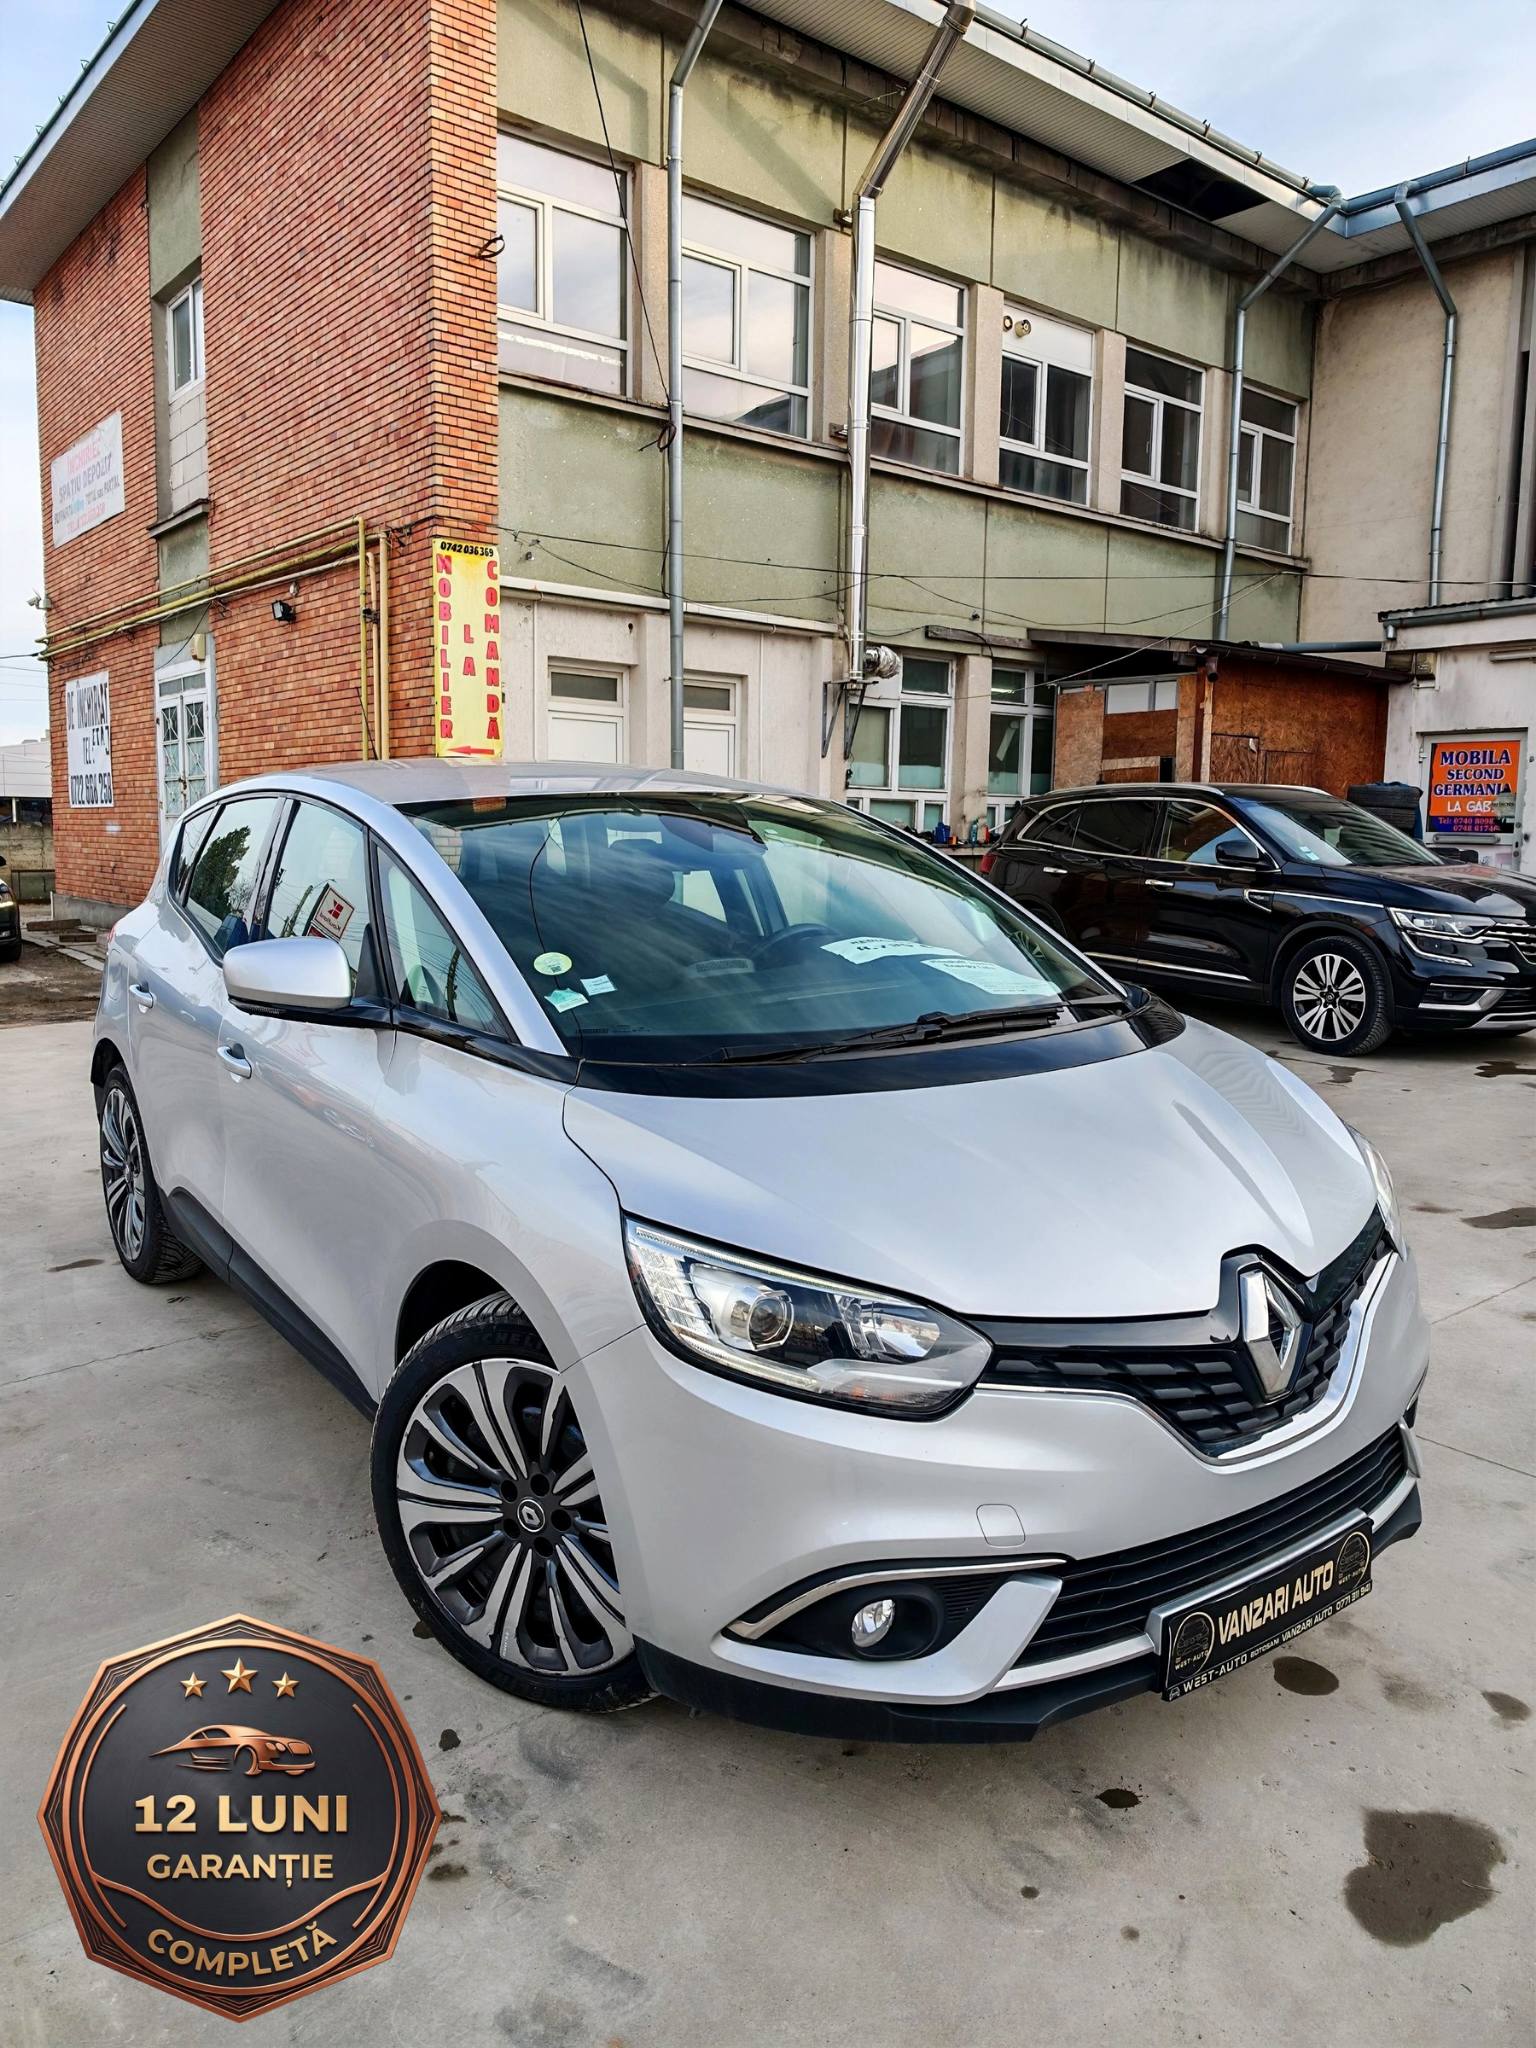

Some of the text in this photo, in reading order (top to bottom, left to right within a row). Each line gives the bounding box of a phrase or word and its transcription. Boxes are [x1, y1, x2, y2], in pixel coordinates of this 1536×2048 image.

[440, 541, 494, 557] 0742 036 369
[1440, 749, 1511, 766] MOBILA
[1447, 768, 1504, 780] SECOND
[1433, 783, 1512, 796] GERMANIA
[1447, 801, 1461, 813] LA
[1218, 1560, 1334, 1645] VANZARI AUTO
[1183, 1653, 1248, 1693] WEST-AUTO
[1281, 1617, 1313, 1642] VANZARI
[1313, 1606, 1333, 1625] AUTO
[1175, 1650, 1210, 1671] WEST-AUTO
